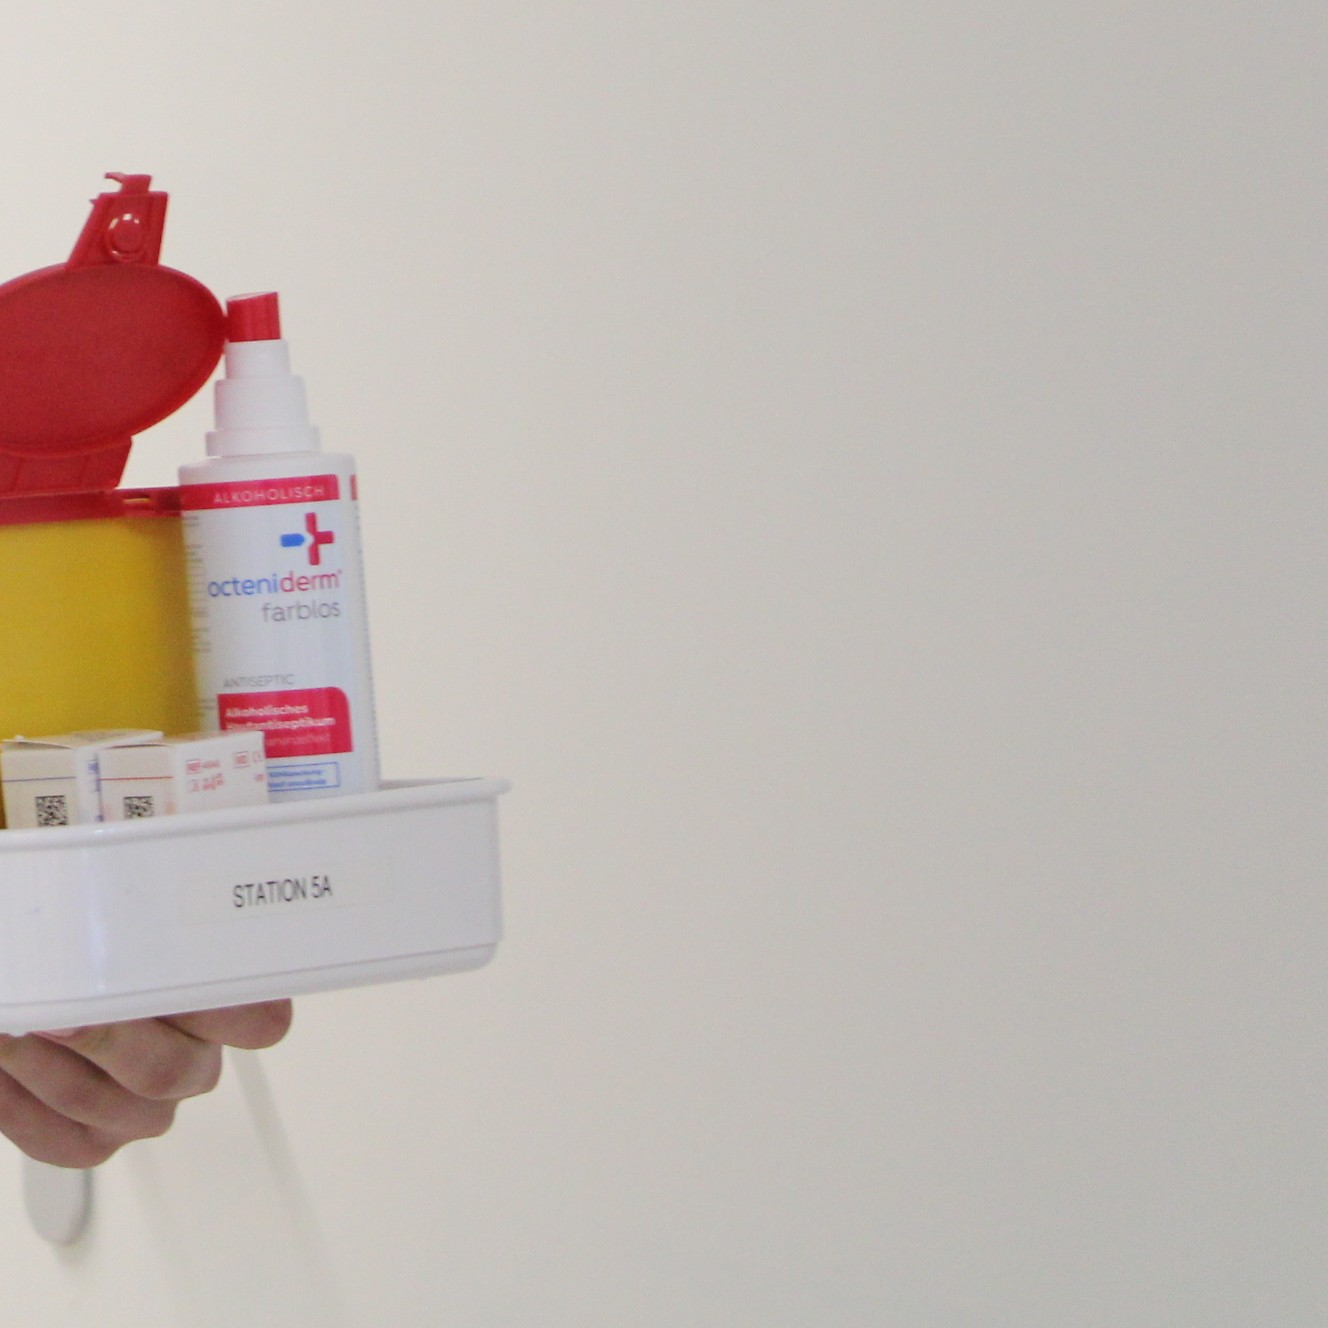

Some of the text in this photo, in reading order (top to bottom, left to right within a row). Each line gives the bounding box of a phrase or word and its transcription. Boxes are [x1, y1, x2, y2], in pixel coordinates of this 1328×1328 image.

[213, 486, 325, 505] ALKOHOLISCH
[263, 598, 341, 623] farblos
[223, 674, 294, 688] ANTISEPTIC
[225, 704, 309, 718] Alkoholisches
[233, 874, 333, 908] STATION 5A
